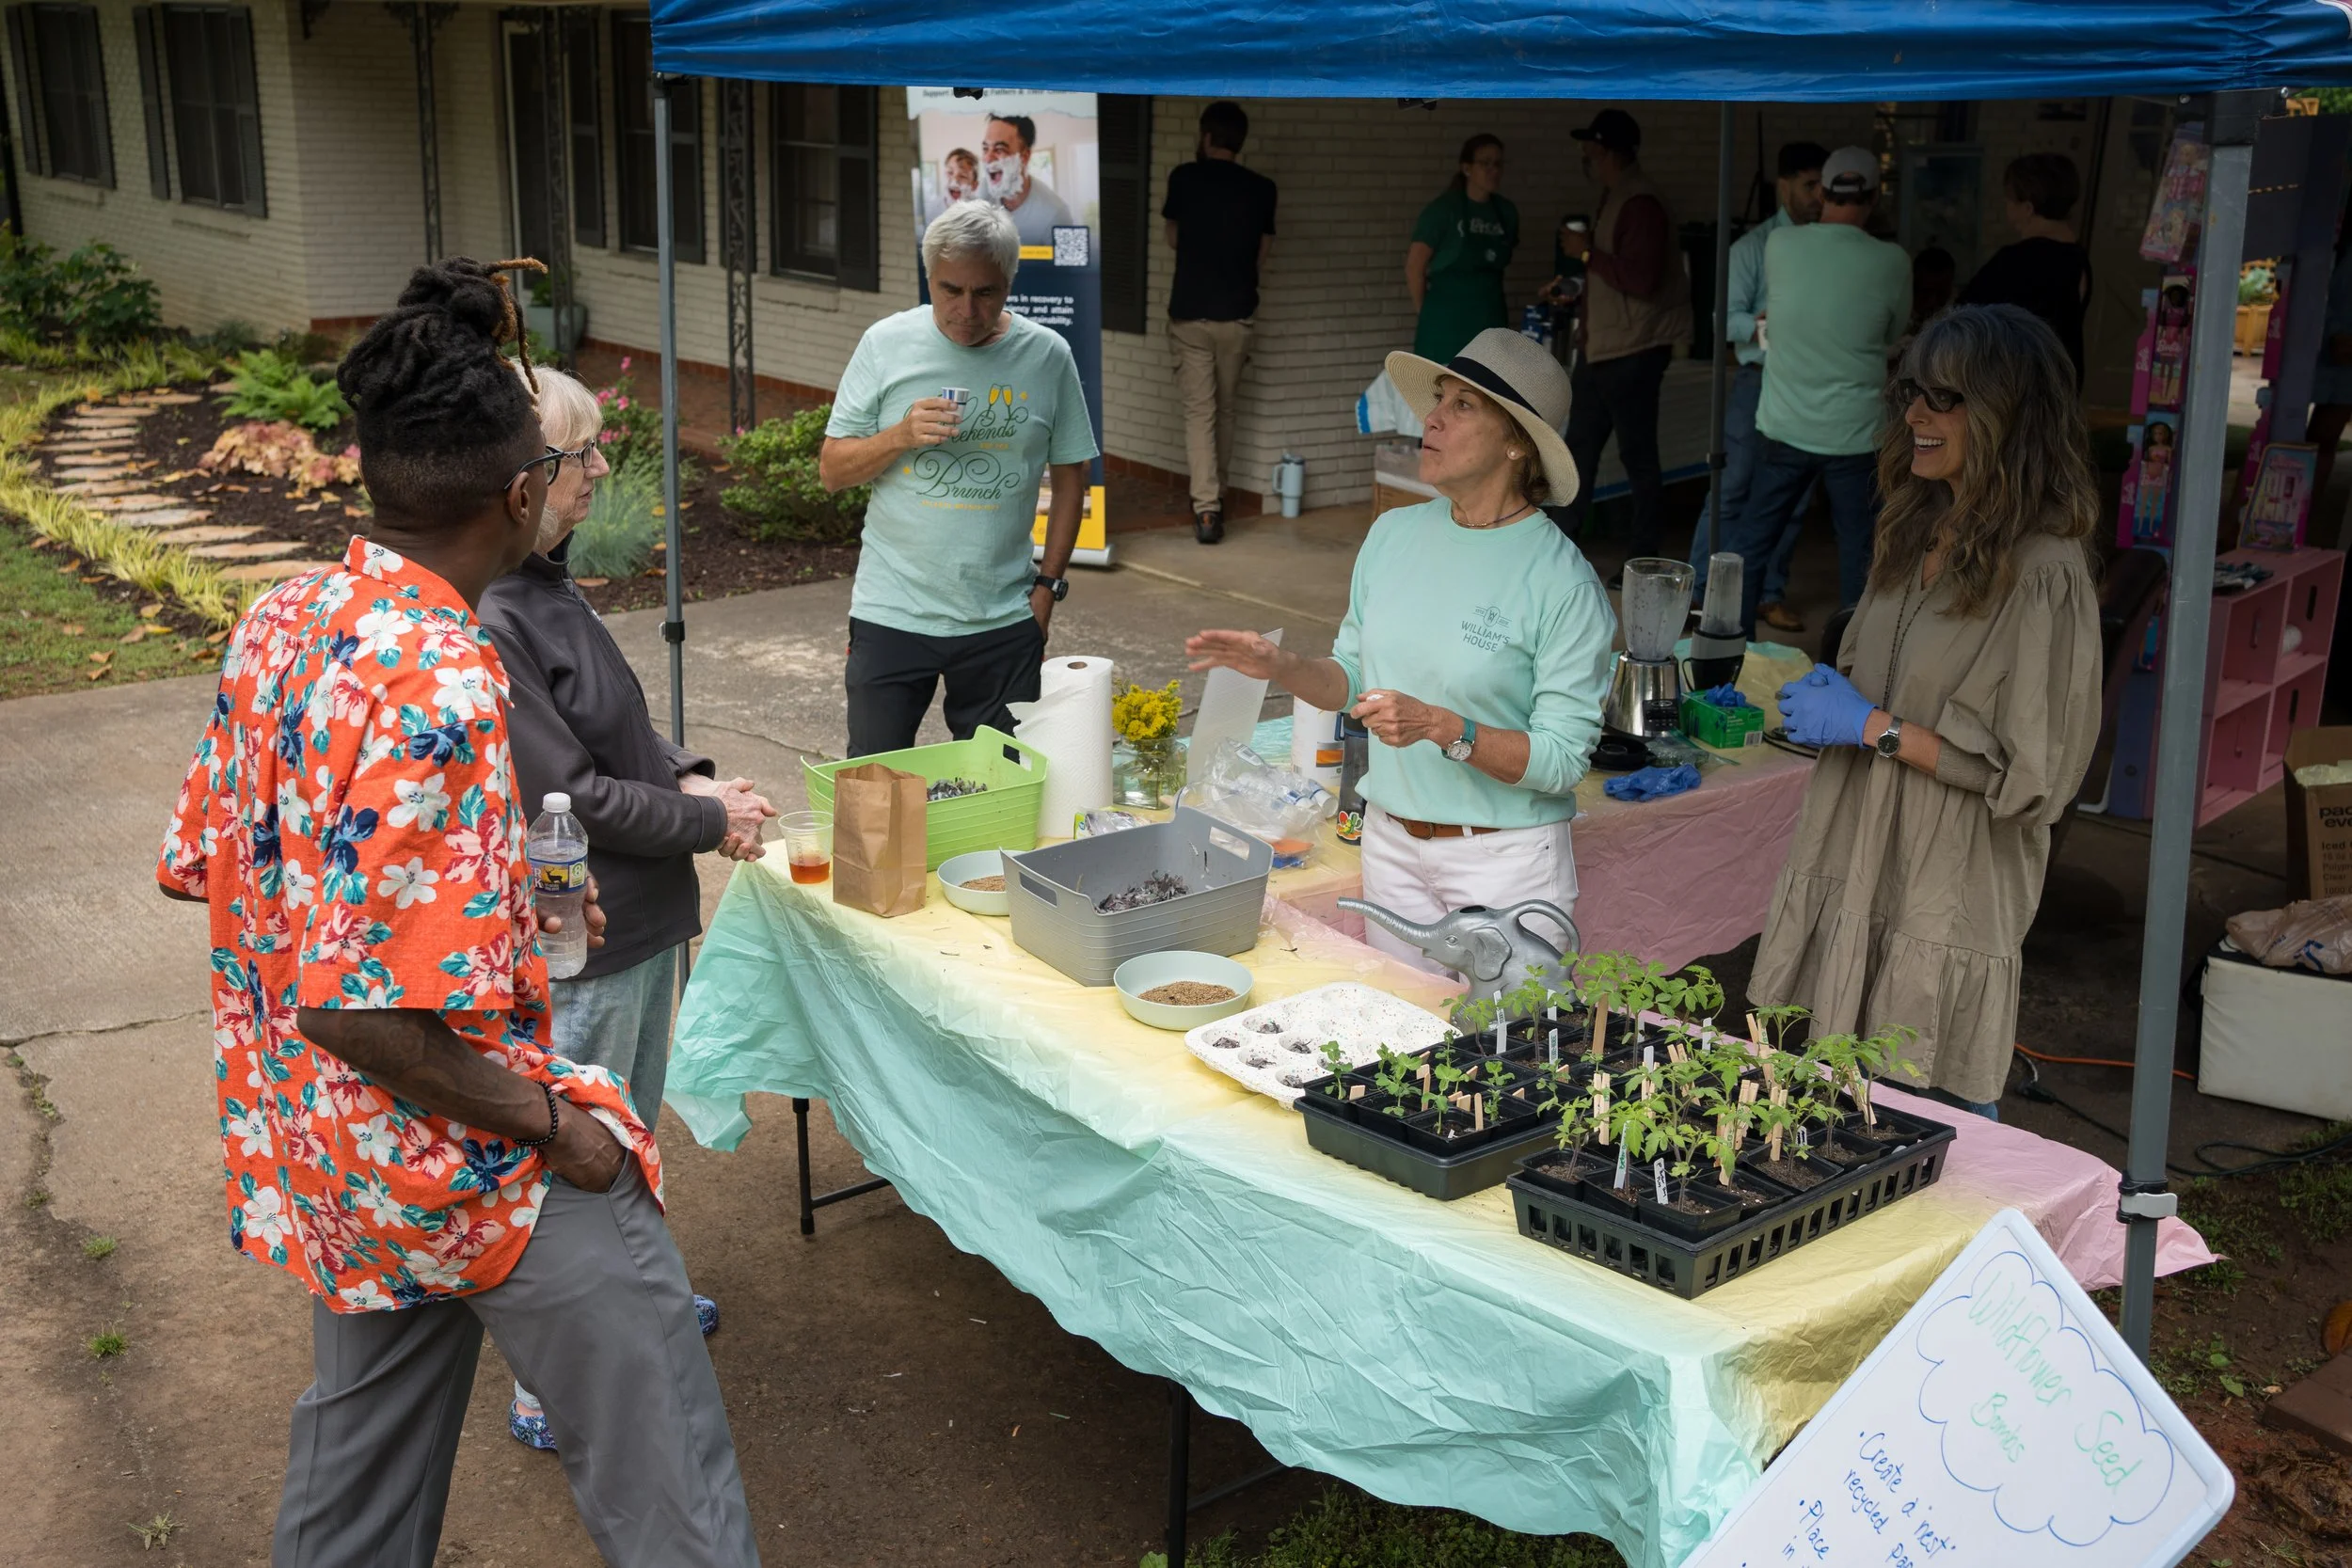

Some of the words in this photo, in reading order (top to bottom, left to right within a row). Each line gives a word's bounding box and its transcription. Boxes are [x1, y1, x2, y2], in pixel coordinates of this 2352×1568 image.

[1007, 304, 1030, 314] iency
[1051, 306, 1074, 314] attain
[1020, 293, 1029, 303] in
[1030, 295, 1062, 306] recovery
[1064, 295, 1074, 305] to
[1026, 315, 1073, 326] stainability.
[2136, 346, 2150, 372] Barbie
[915, 450, 1021, 499] Brunch
[1461, 620, 1511, 645] WILLIAM'S
[1463, 633, 1498, 653] HOUSE
[2322, 841, 2345, 850] Iced
[1970, 1391, 2025, 1464] Bombs
[1859, 1433, 1904, 1494] Create
[2074, 1410, 2144, 1496] Seed
[1843, 1468, 1890, 1535] recycled
[1799, 1499, 1830, 1560] Place
[1782, 1534, 1797, 1561] in
